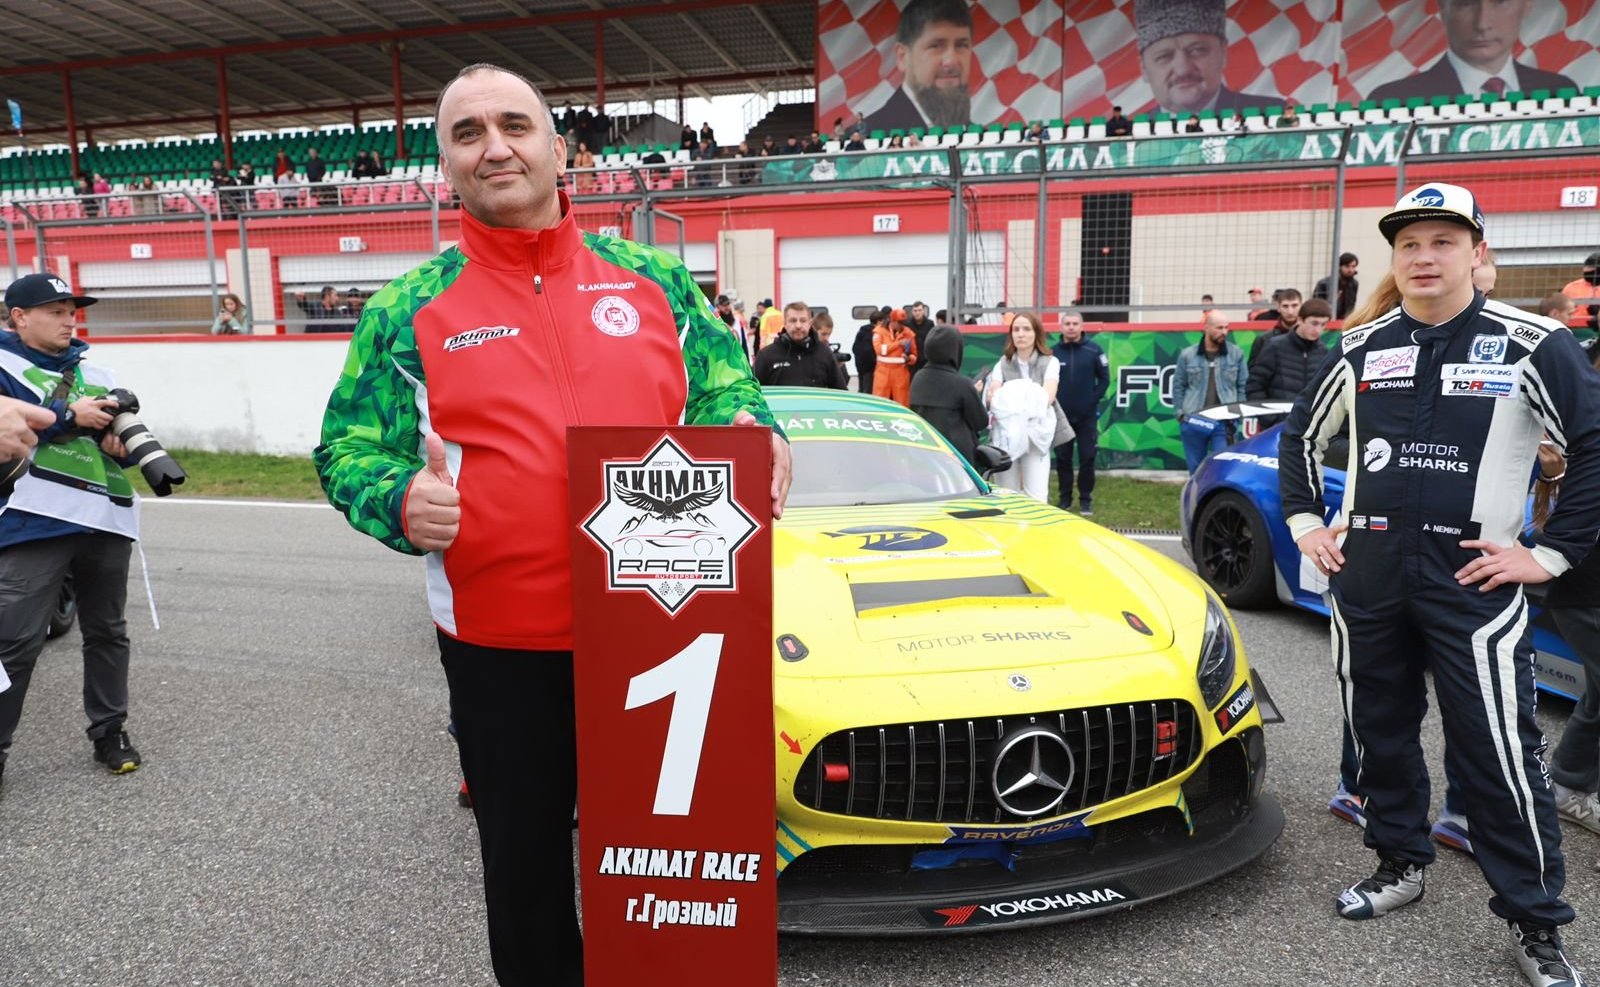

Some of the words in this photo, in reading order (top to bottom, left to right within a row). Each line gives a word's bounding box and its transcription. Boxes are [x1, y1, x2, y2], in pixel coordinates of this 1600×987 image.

[1344, 332, 1365, 346] OMP
[1513, 327, 1541, 342] OMP
[1369, 379, 1415, 390] YOKOHAMA
[1451, 381, 1484, 391] TCR
[1483, 383, 1511, 391] Russia
[822, 418, 888, 432] RACE
[1401, 442, 1460, 458] MOTOR
[1398, 456, 1470, 473] SHARKS
[616, 470, 721, 500] AKHMAT
[1433, 525, 1462, 536] NEMKIN
[617, 559, 724, 573] RACE
[897, 634, 976, 653] MOTOR
[981, 631, 1072, 644] SHARKS
[624, 633, 725, 816] 1
[962, 818, 1077, 841] RAVENOL
[599, 846, 697, 878] AKHMAT
[701, 850, 761, 882] RACE
[979, 887, 1126, 918] YOKOHAMA
[625, 893, 738, 930] г.Грозный
